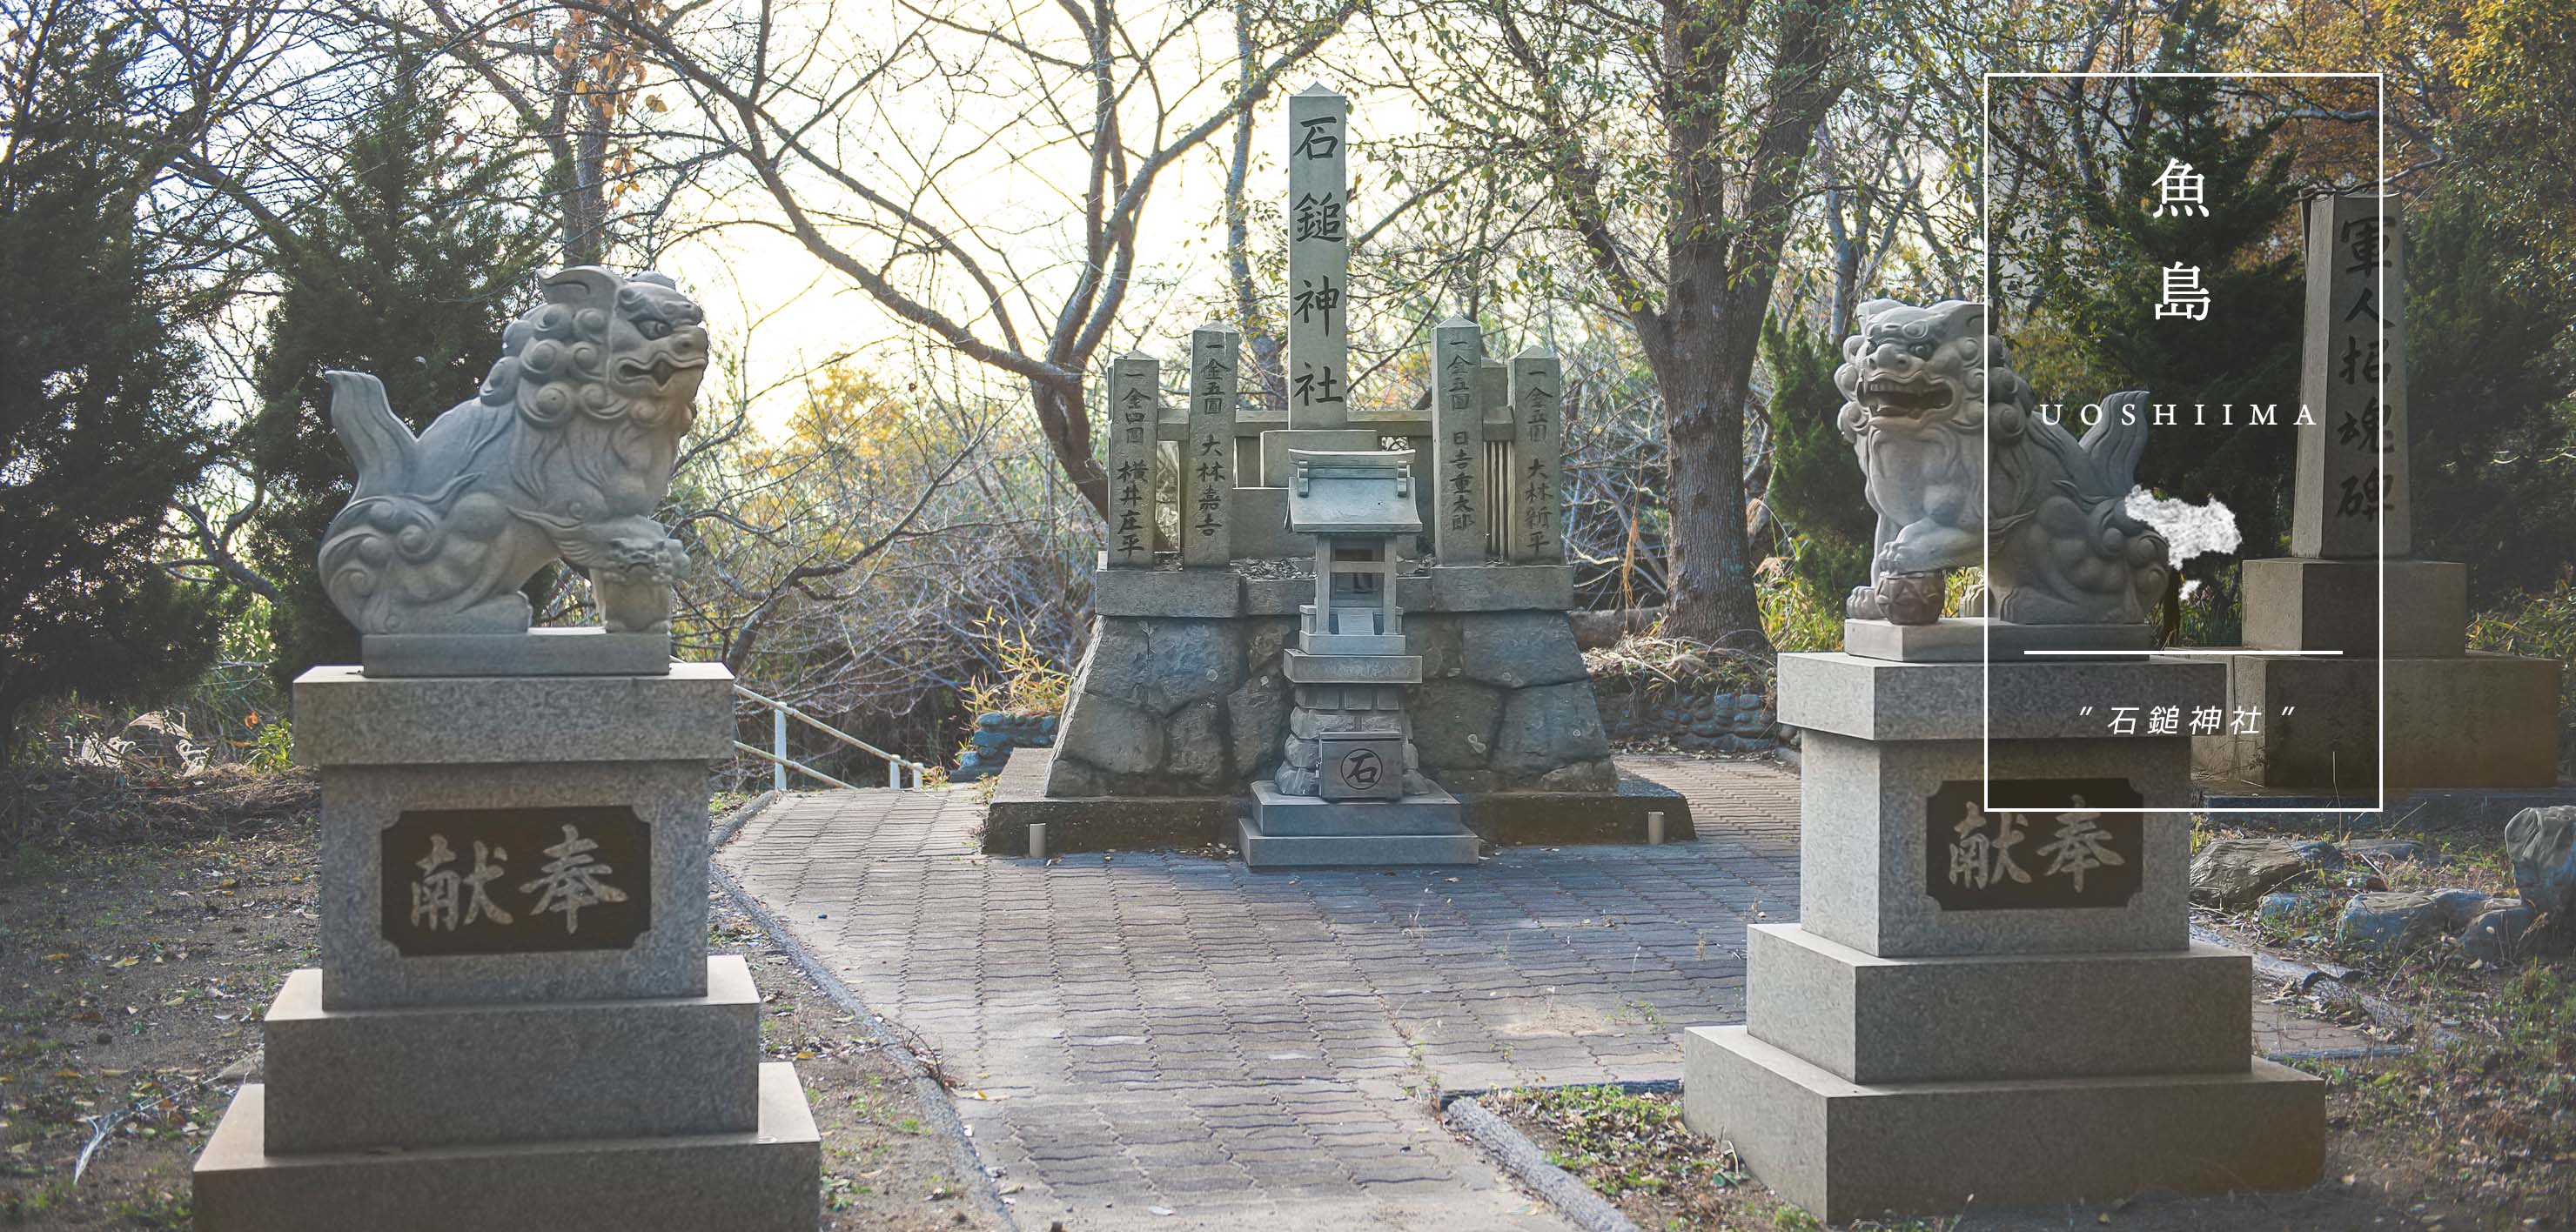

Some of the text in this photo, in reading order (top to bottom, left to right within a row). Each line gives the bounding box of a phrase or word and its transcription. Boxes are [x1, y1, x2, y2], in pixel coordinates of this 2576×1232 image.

[1293, 116, 1344, 406] 石鎚神社
[1347, 753, 1379, 784] 石
